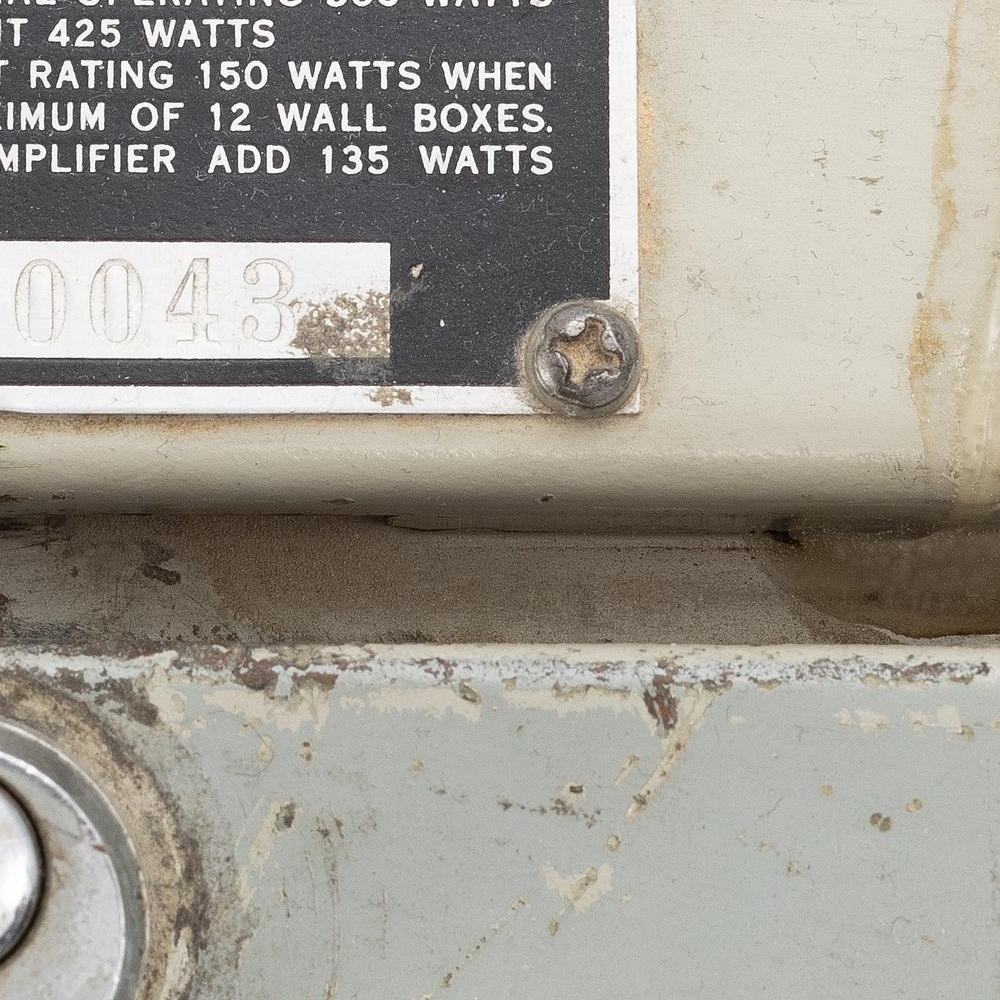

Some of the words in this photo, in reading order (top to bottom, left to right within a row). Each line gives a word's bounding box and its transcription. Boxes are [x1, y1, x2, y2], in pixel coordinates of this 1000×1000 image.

[47, 18, 121, 48] 425
[142, 18, 276, 49] WATTS
[29, 59, 174, 90] RATING
[200, 60, 269, 91] 150
[287, 60, 421, 91] WATTS
[441, 61, 552, 91] WHEN
[130, 101, 185, 132] OF
[210, 102, 251, 132] 12
[276, 101, 387, 133] WALL
[414, 102, 553, 133] BOXES.
[207, 144, 291, 174] ADD
[321, 144, 389, 175] 135
[418, 144, 553, 176] WATTS
